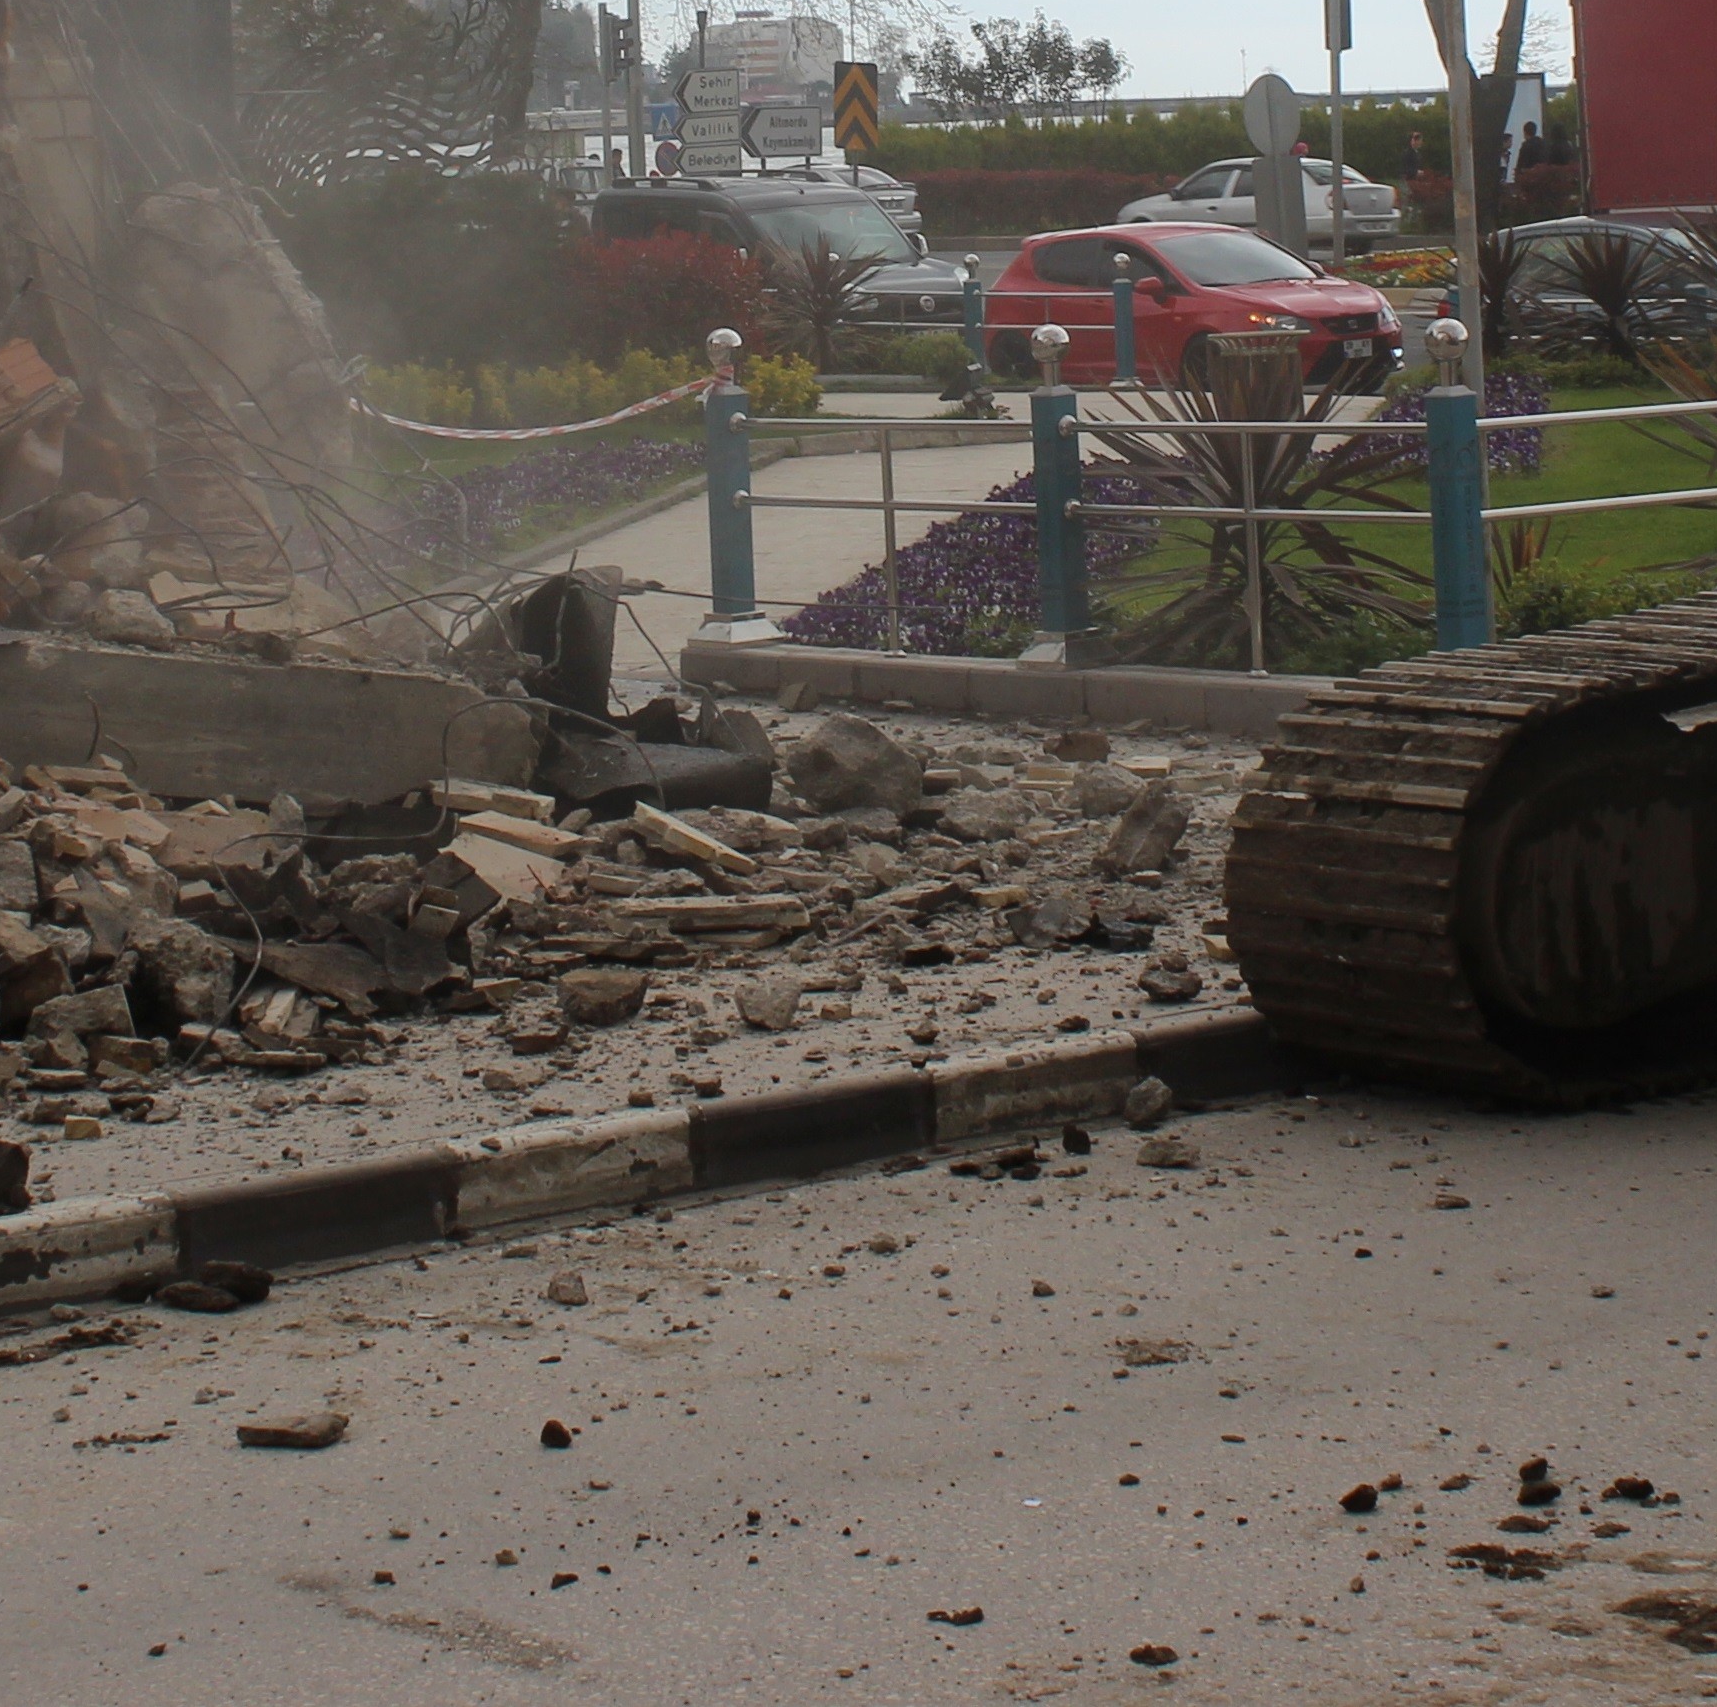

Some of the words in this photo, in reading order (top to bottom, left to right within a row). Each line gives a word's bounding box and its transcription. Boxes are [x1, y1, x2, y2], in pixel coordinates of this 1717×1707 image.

[693, 95, 737, 108] Merkezi
[691, 121, 735, 137] Valilik
[688, 154, 737, 168] Belediye
